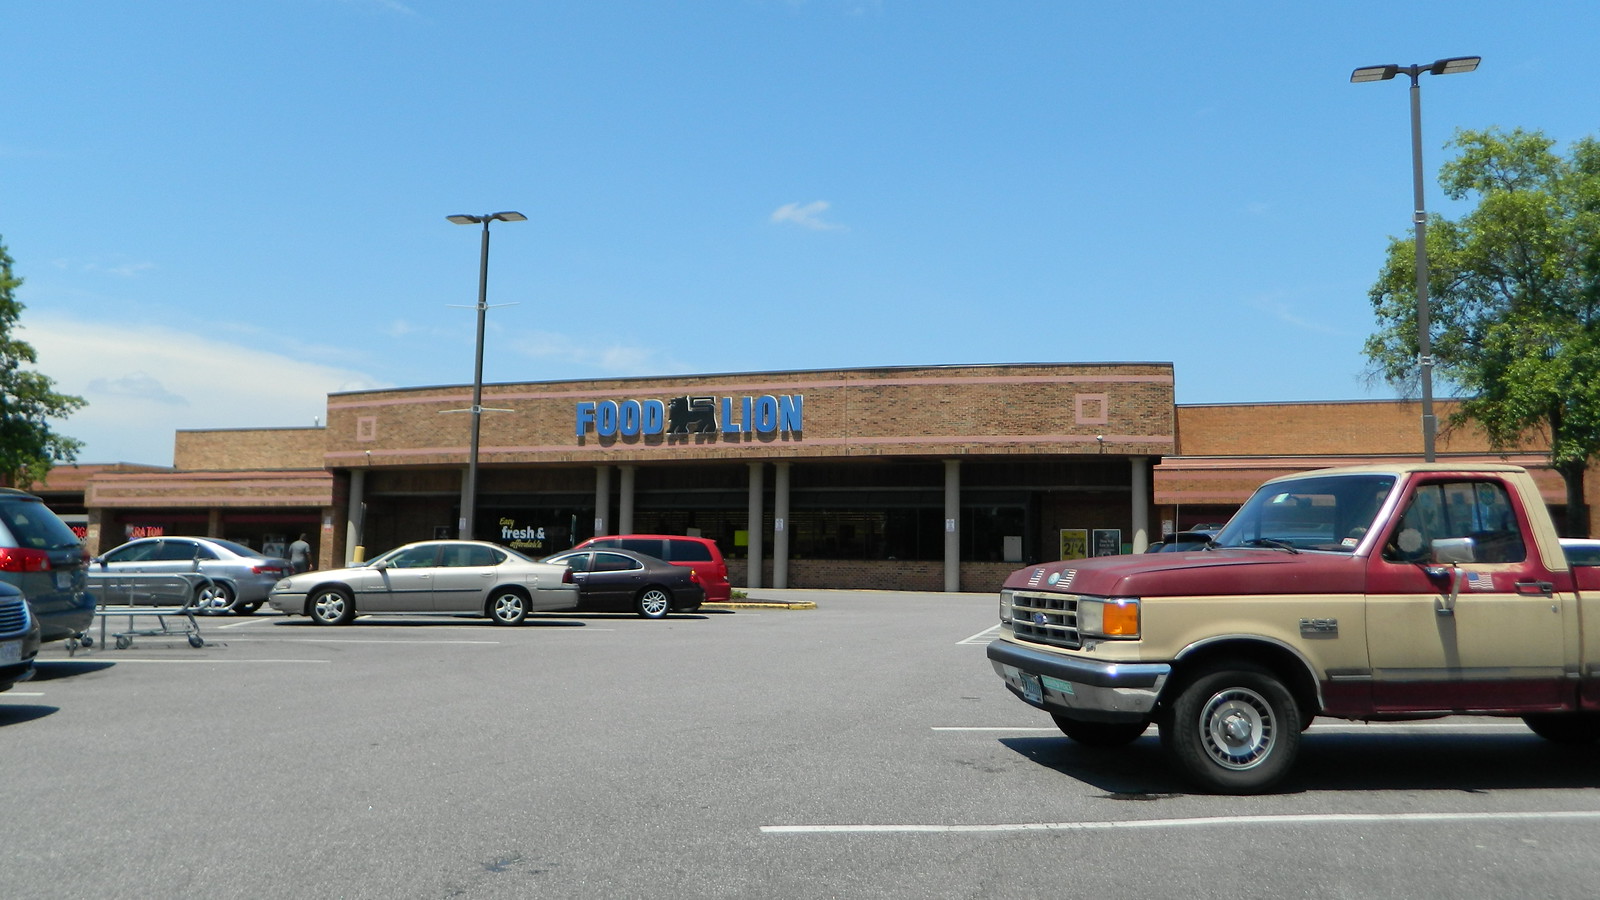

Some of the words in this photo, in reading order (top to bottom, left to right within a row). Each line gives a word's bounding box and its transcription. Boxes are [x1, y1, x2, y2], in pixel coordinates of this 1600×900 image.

[576, 400, 665, 437] FOOD
[721, 394, 803, 433] LION
[502, 525, 534, 539] fresh
[537, 527, 545, 539] &
